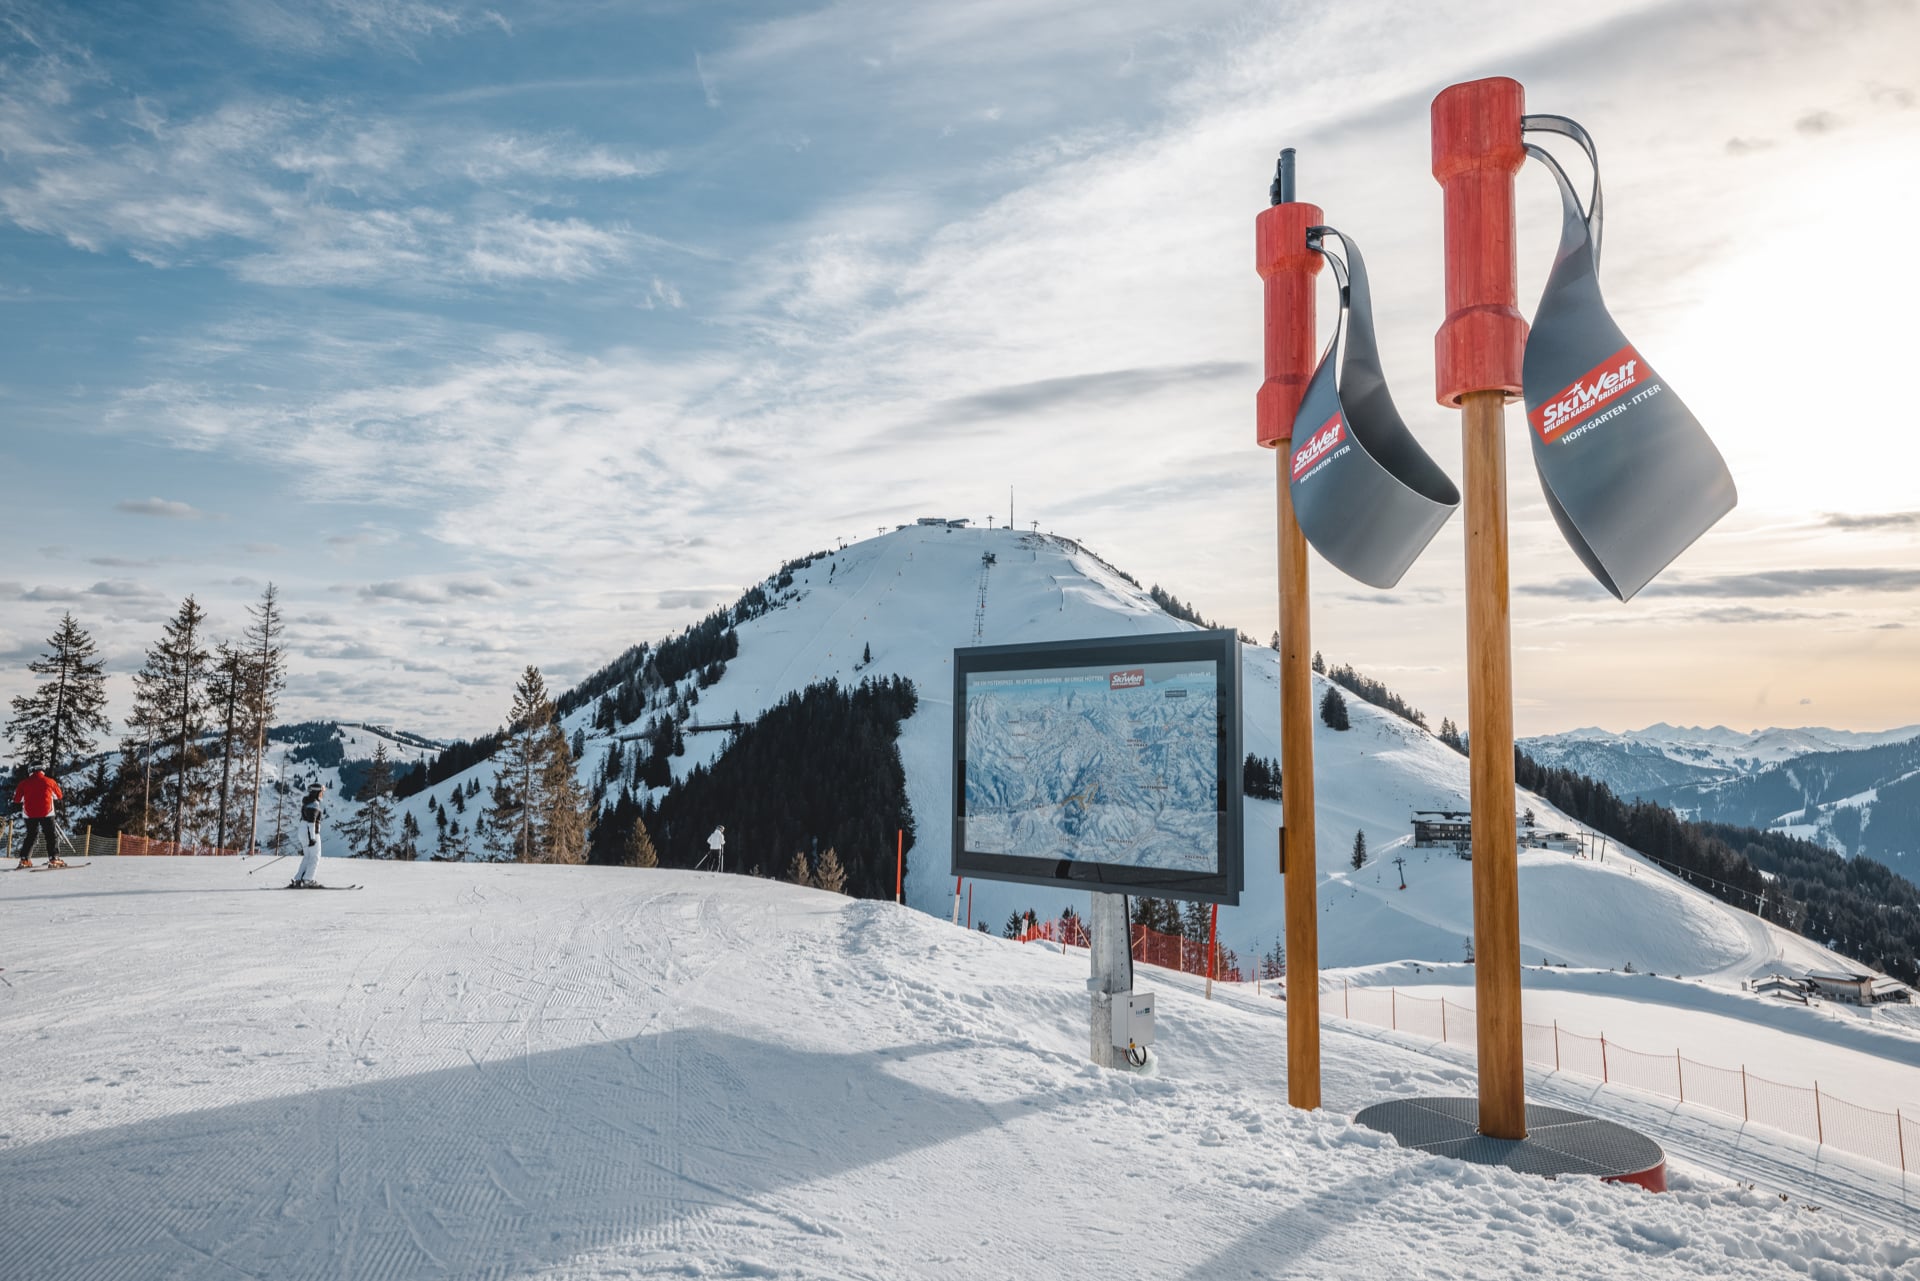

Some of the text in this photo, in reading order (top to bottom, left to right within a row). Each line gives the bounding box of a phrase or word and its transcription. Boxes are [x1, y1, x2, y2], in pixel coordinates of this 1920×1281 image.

[1543, 359, 1637, 427] SkiWelt
[1543, 376, 1636, 434] WILDER KAISER BRIXENTAL
[1561, 402, 1628, 445] HOPFGARTEN
[1632, 384, 1662, 406] ITTER
[1295, 423, 1341, 468] SkiWelt
[1300, 456, 1331, 485] HOPFGARTEN
[1334, 445, 1351, 460] ITTER
[1112, 672, 1143, 683] SkiWelt
